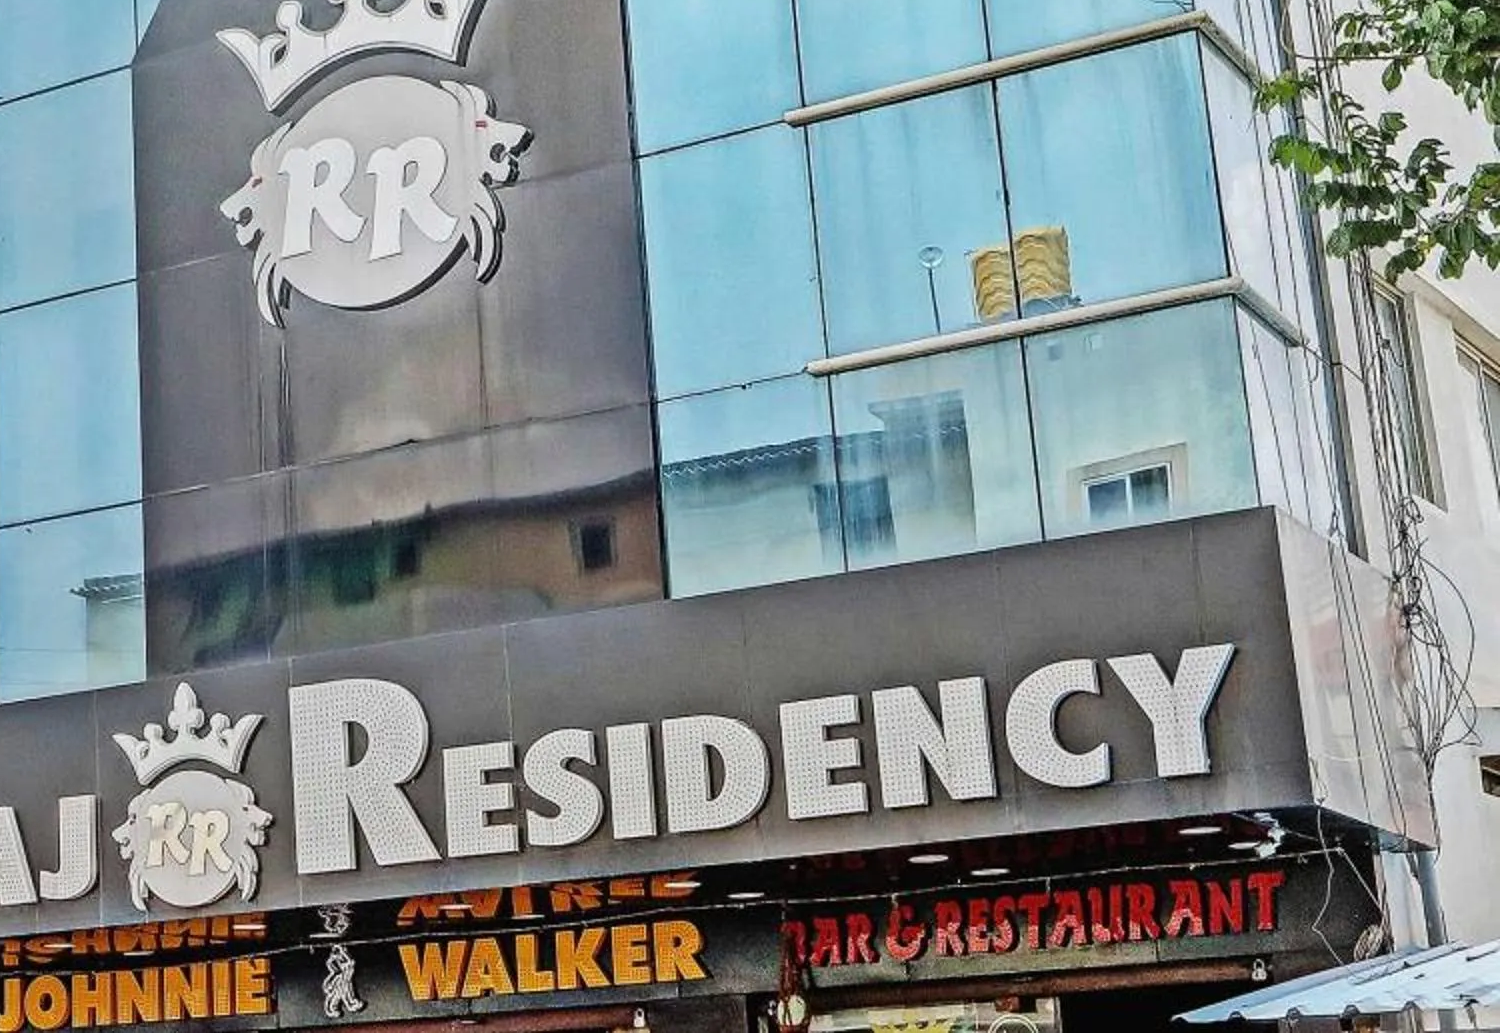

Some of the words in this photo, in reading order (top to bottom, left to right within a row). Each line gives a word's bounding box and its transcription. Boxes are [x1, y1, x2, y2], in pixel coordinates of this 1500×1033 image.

[278, 137, 460, 263] RR
[288, 643, 1236, 875] RESIDENCY
[144, 801, 233, 876] RR
[934, 871, 1286, 959] RESTAURANT
[398, 920, 708, 1002] WALKER
